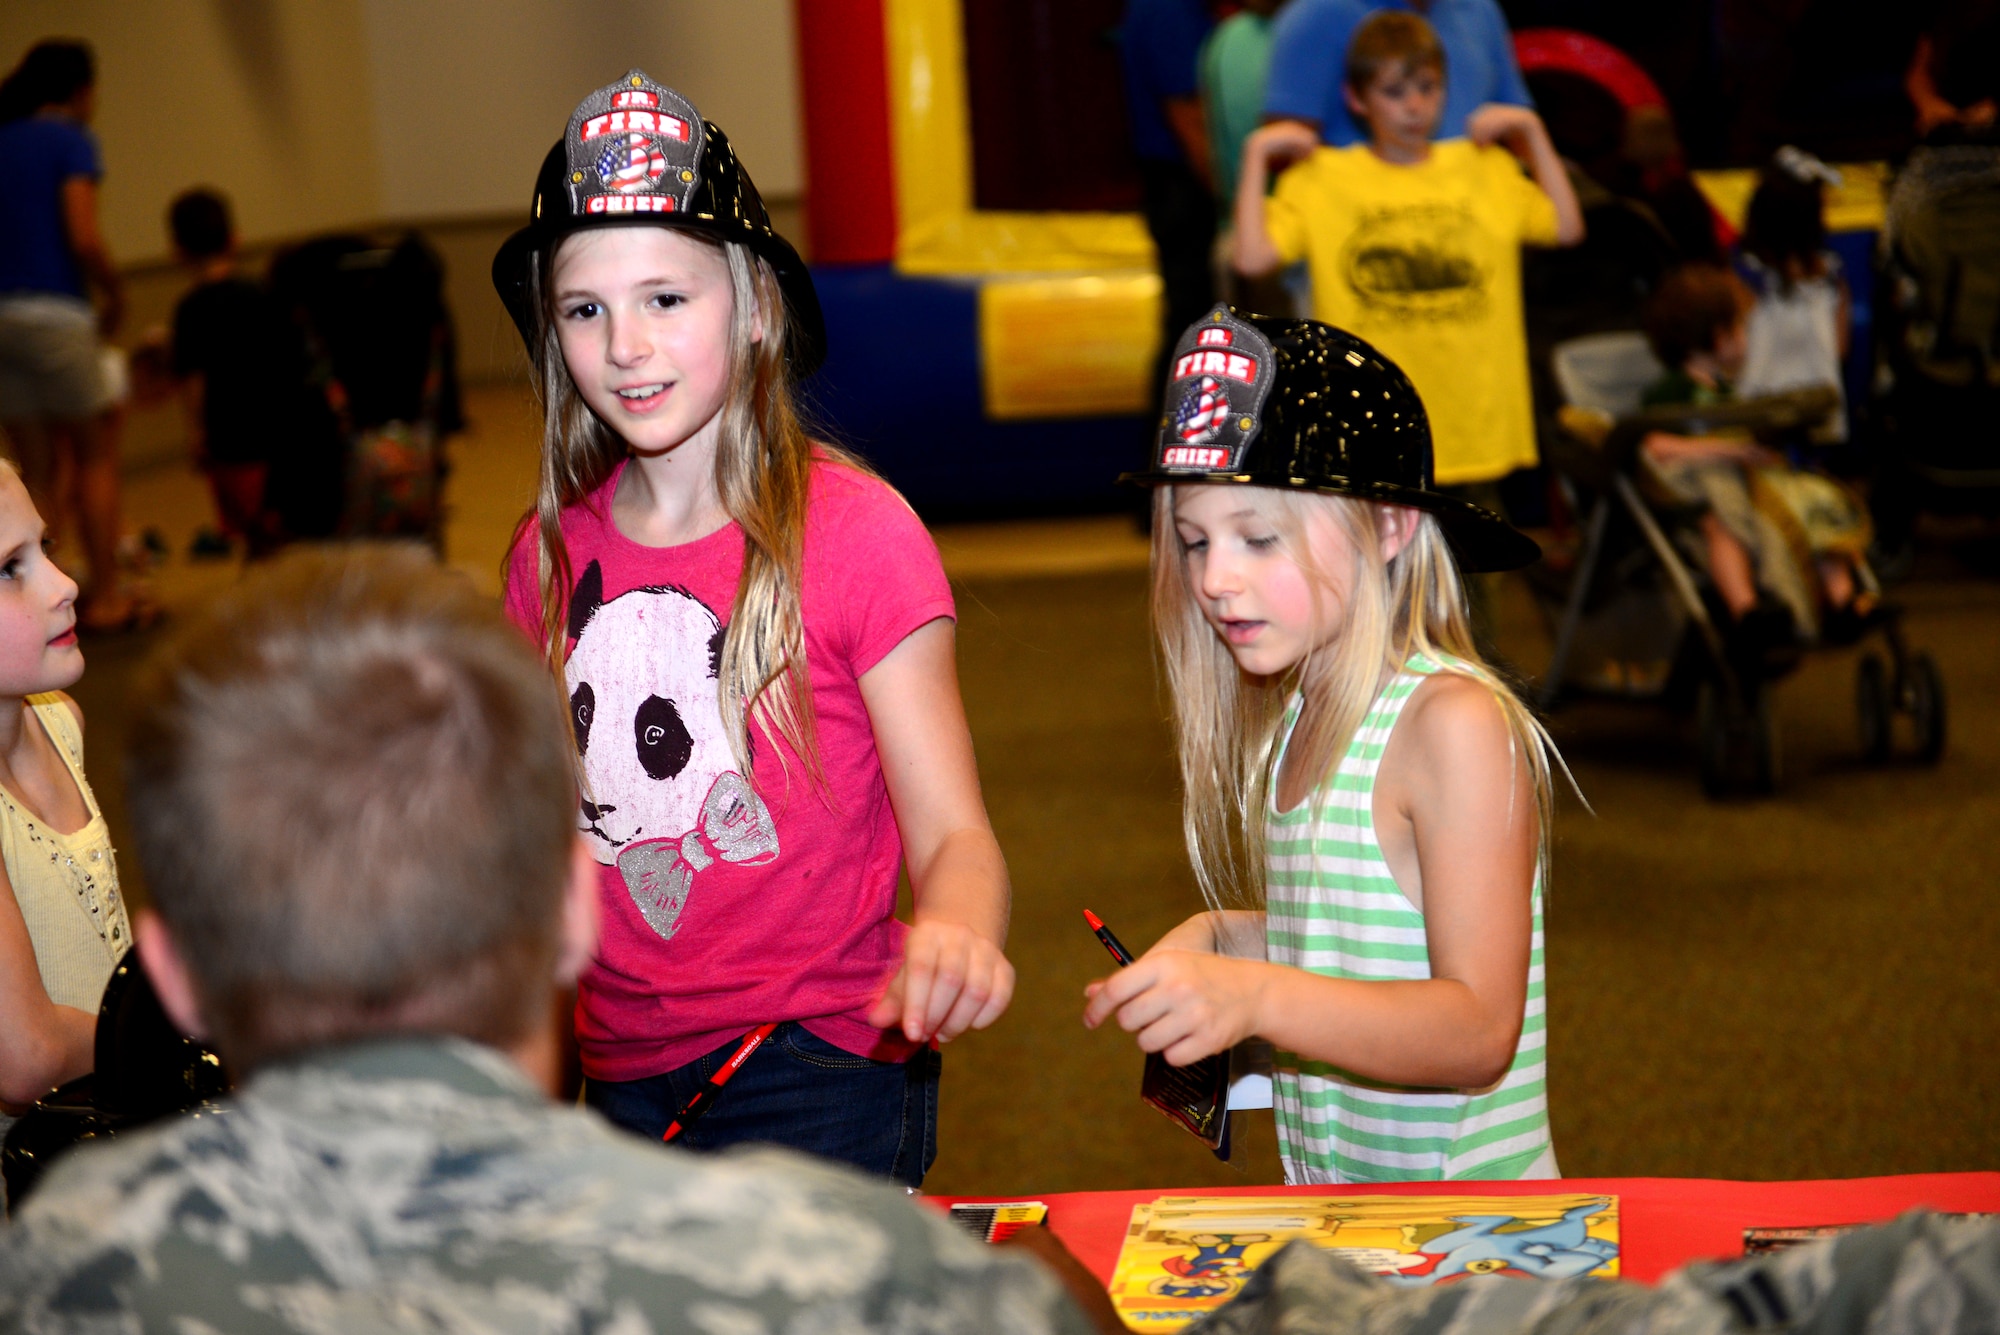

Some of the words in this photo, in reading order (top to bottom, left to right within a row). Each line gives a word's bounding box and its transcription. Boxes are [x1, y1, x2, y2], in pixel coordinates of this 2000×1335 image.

[617, 91, 654, 106] JR.
[585, 111, 681, 140] FIRE
[590, 196, 668, 212] CHIEF
[1200, 328, 1229, 345] JR.
[1174, 350, 1251, 379] FIRE
[1164, 447, 1225, 467] CHIEF
[731, 1034, 761, 1068] BARKSDALE
